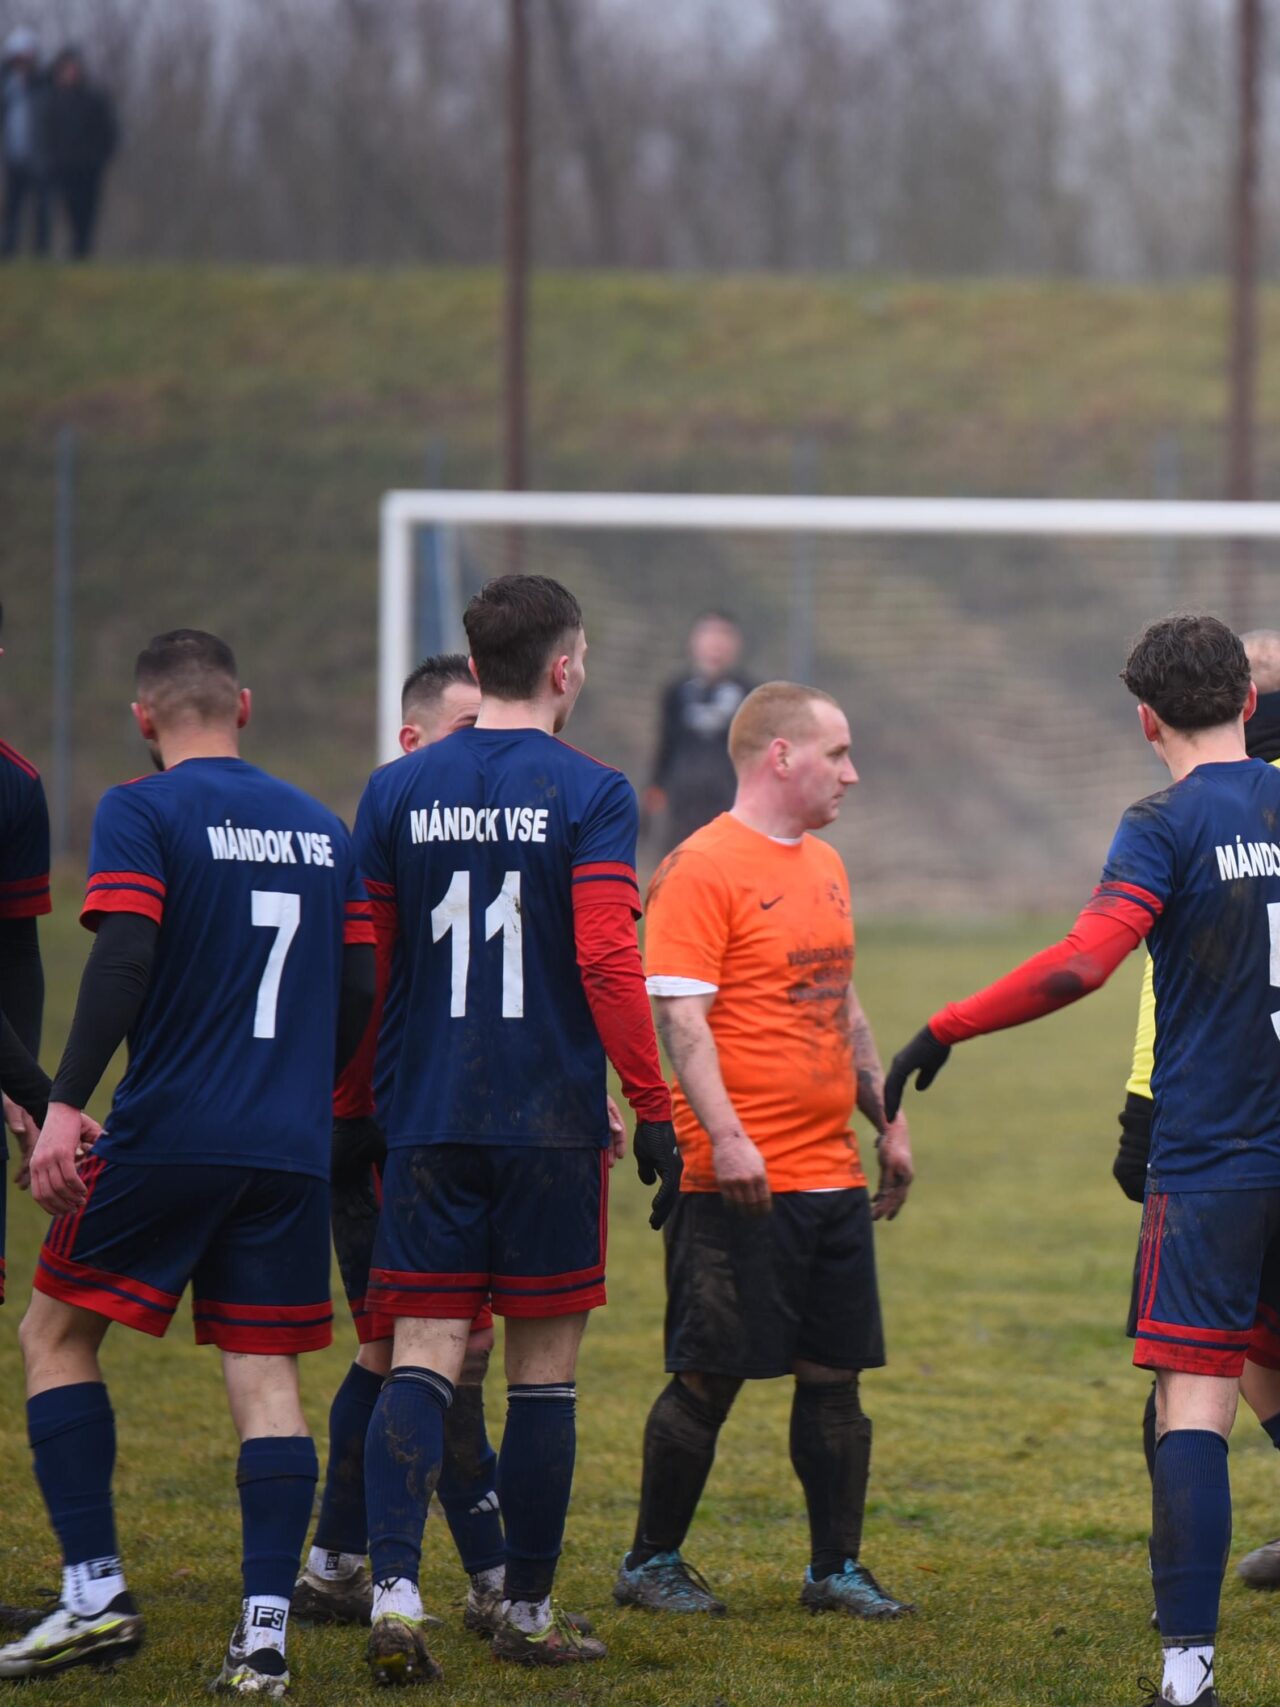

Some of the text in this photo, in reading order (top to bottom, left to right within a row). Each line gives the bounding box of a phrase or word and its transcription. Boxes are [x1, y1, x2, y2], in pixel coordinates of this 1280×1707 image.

[207, 819, 334, 868] MÁNDOK VSE
[411, 800, 549, 844] MÁNDOK VSE
[252, 890, 301, 1039] 7
[431, 870, 524, 1018] 11
[254, 1606, 285, 1631] FS
